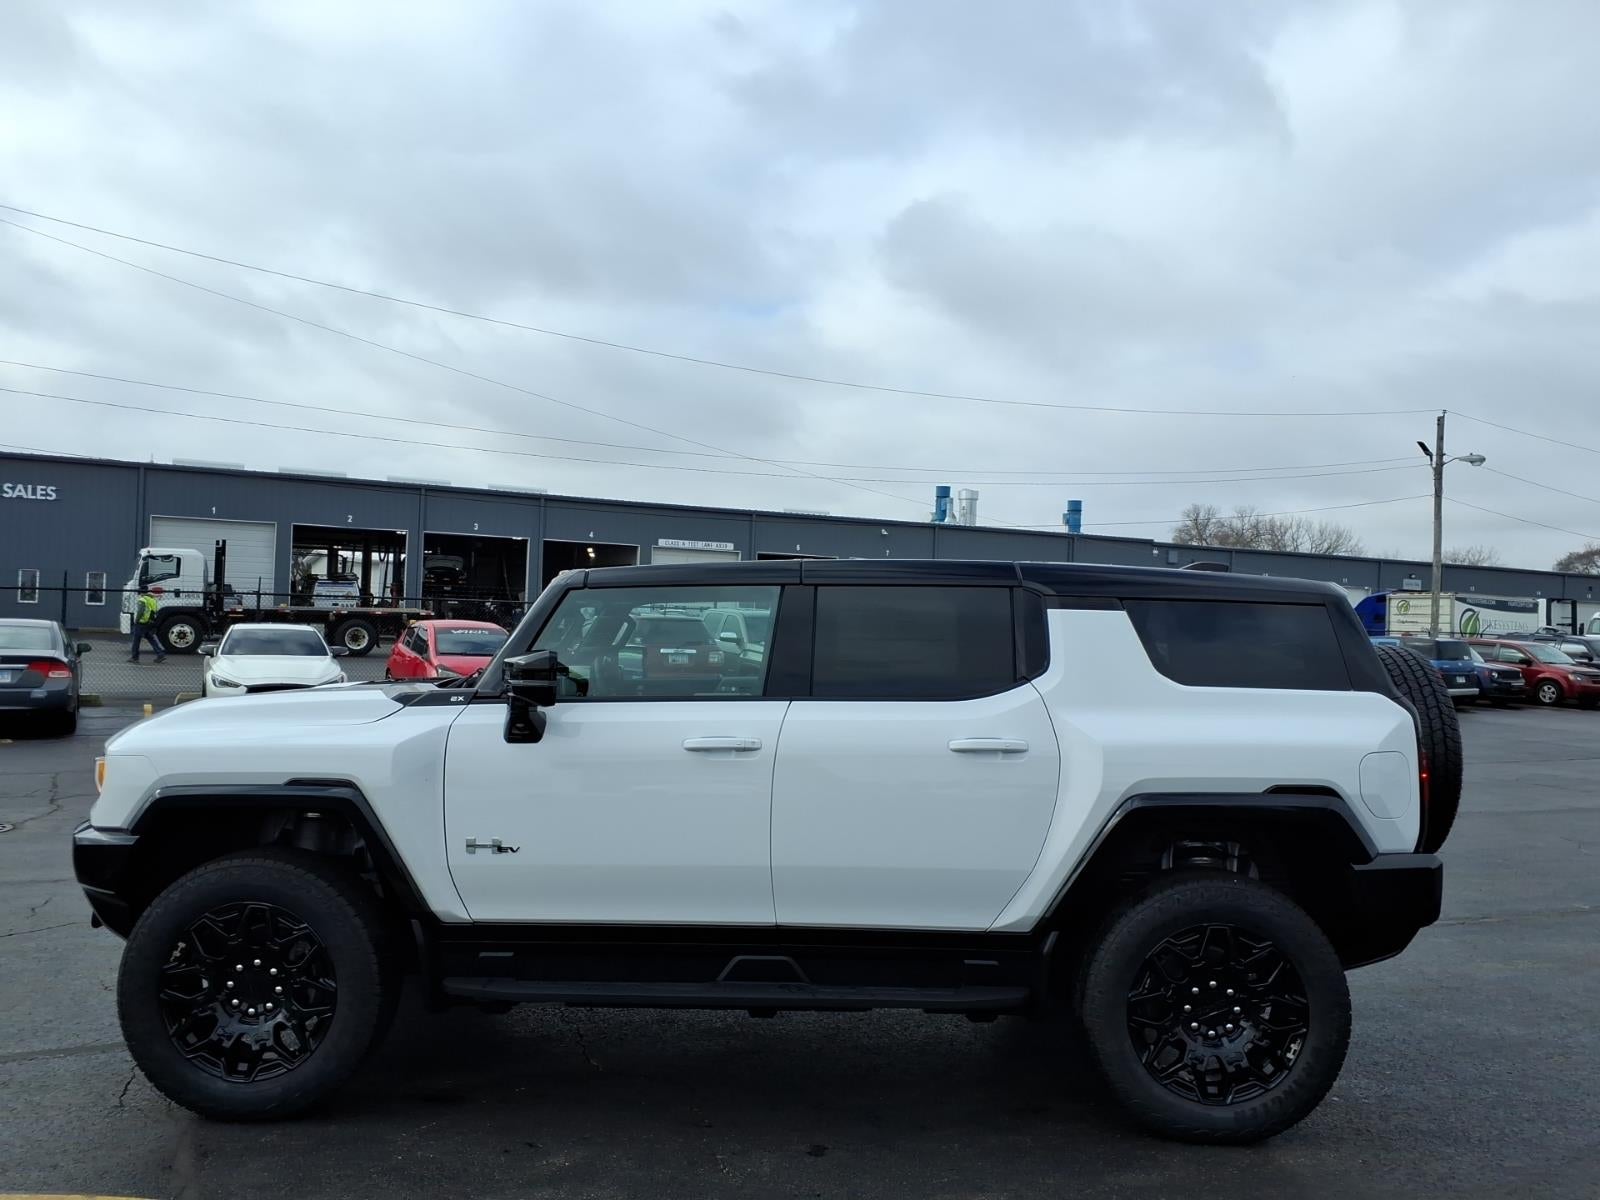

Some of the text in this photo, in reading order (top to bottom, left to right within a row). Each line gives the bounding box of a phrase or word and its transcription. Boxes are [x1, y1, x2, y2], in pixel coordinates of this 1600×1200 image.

[3, 483, 57, 500] SALES
[211, 506, 216, 515] 1
[347, 515, 353, 523] 2
[473, 523, 479, 531] 3
